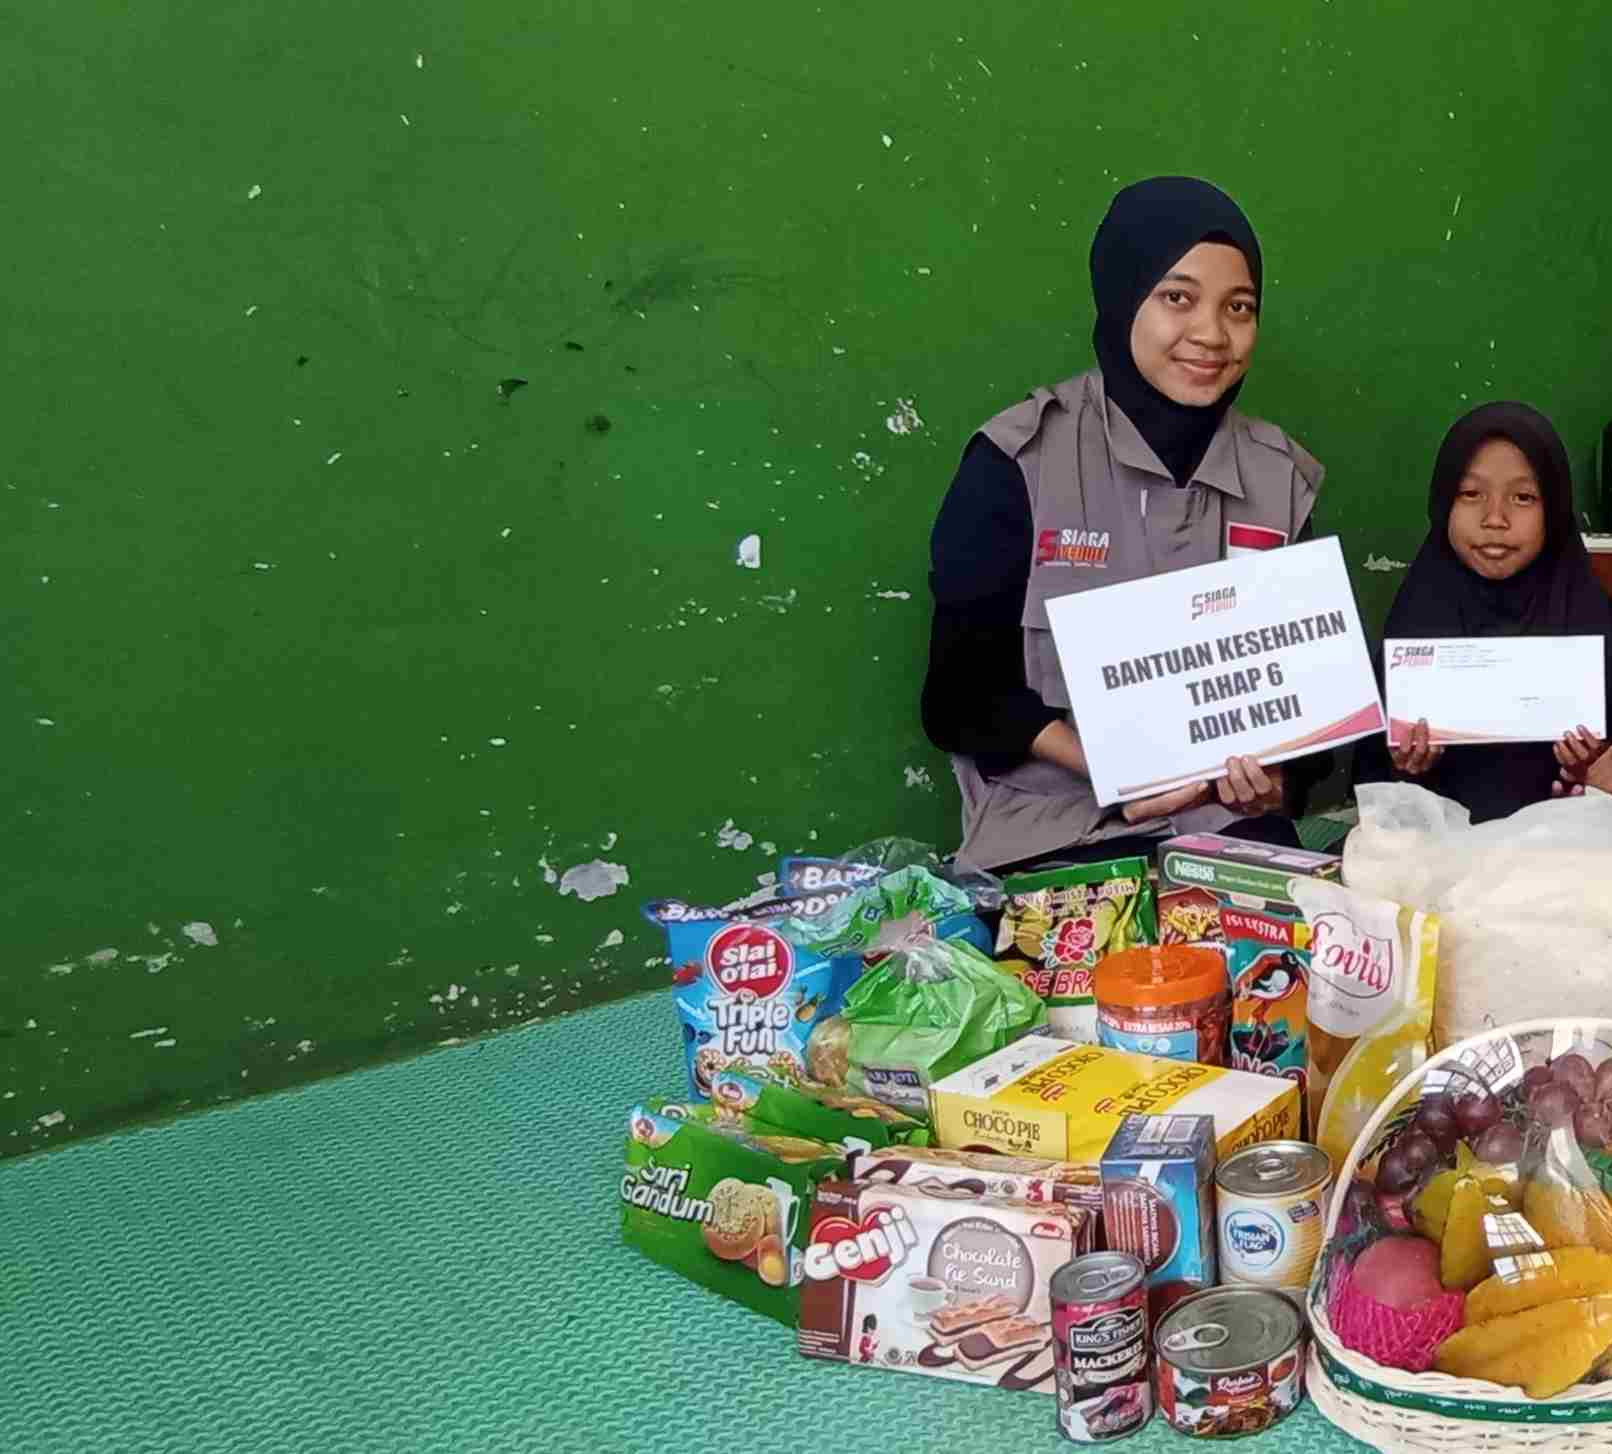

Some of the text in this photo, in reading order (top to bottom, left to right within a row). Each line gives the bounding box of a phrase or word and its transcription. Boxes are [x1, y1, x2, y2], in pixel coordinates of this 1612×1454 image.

[1060, 528, 1110, 548] SIAGA
[1204, 586, 1236, 602] SIAGA
[1101, 610, 1347, 690] BANTUAN KESEHATAN
[1405, 646, 1435, 657] SIAGA
[1186, 662, 1284, 707] TAHAP 6
[1188, 694, 1302, 744] ADIK NEVI
[1243, 916, 1289, 942] EKSTRA
[708, 1000, 789, 1030] Triple
[722, 1025, 776, 1054] Fun
[963, 1109, 1016, 1136] CHOCO
[1017, 1120, 1041, 1141] PIE
[641, 1158, 692, 1190] Sari
[620, 1176, 716, 1224] Gandum
[804, 1205, 919, 1281] Genji
[1232, 1227, 1271, 1243] FRISIAN
[1239, 1238, 1264, 1250] FLAG
[943, 1242, 1023, 1269] Chocolate
